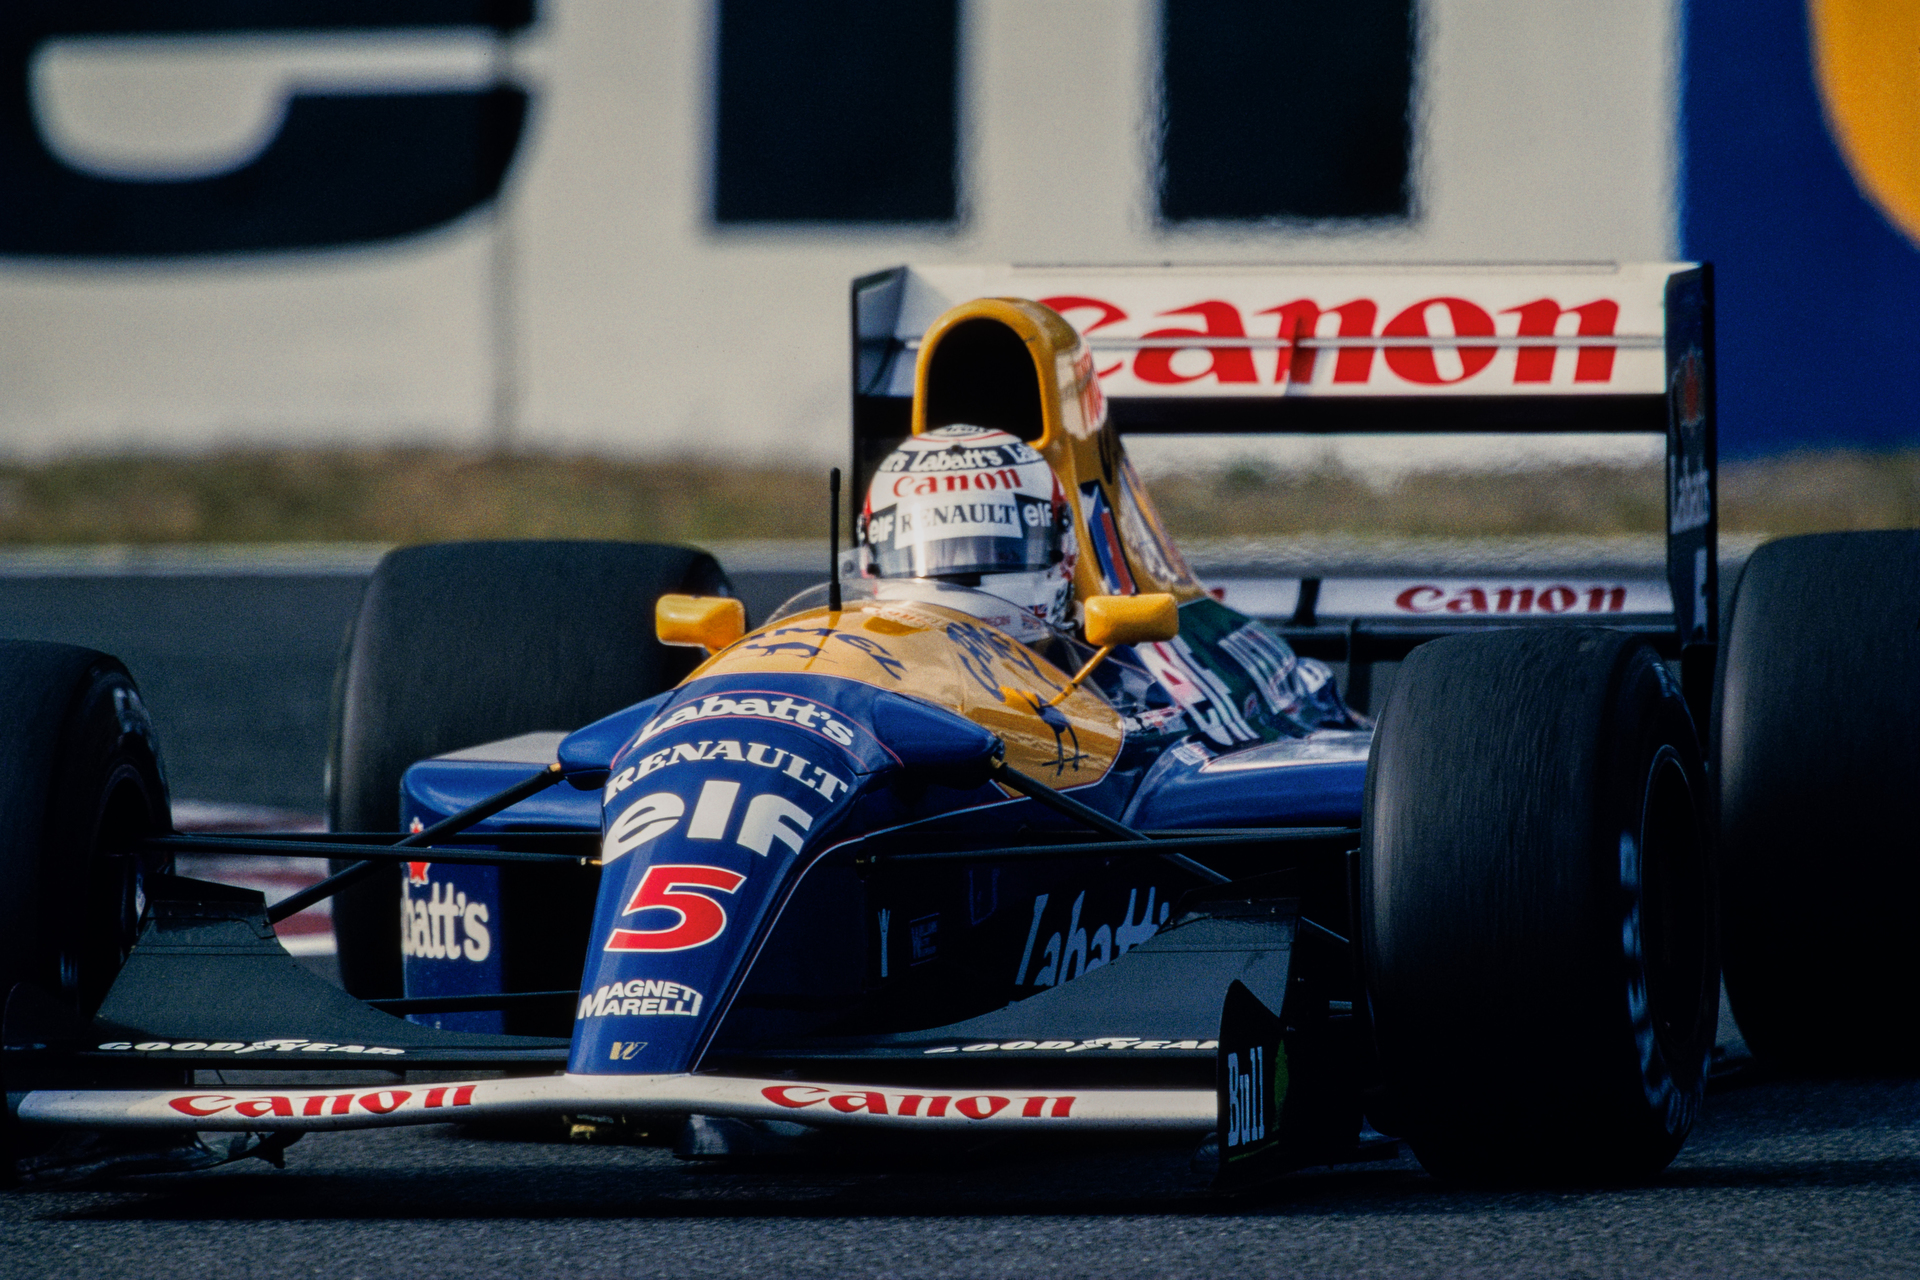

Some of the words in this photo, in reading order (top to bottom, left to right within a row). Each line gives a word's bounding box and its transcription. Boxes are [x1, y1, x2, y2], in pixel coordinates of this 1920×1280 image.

[908, 448, 1004, 473] Labatt's
[892, 468, 1023, 498] Canon
[868, 514, 897, 544] elf
[1022, 502, 1053, 528] elf
[1395, 584, 1627, 614] Canon
[632, 696, 855, 748] Labatt's
[602, 740, 849, 808] RENAULT
[602, 780, 814, 867] elf
[603, 864, 748, 953] 5
[167, 1084, 478, 1118] Canon
[760, 1084, 1078, 1120] Canon
